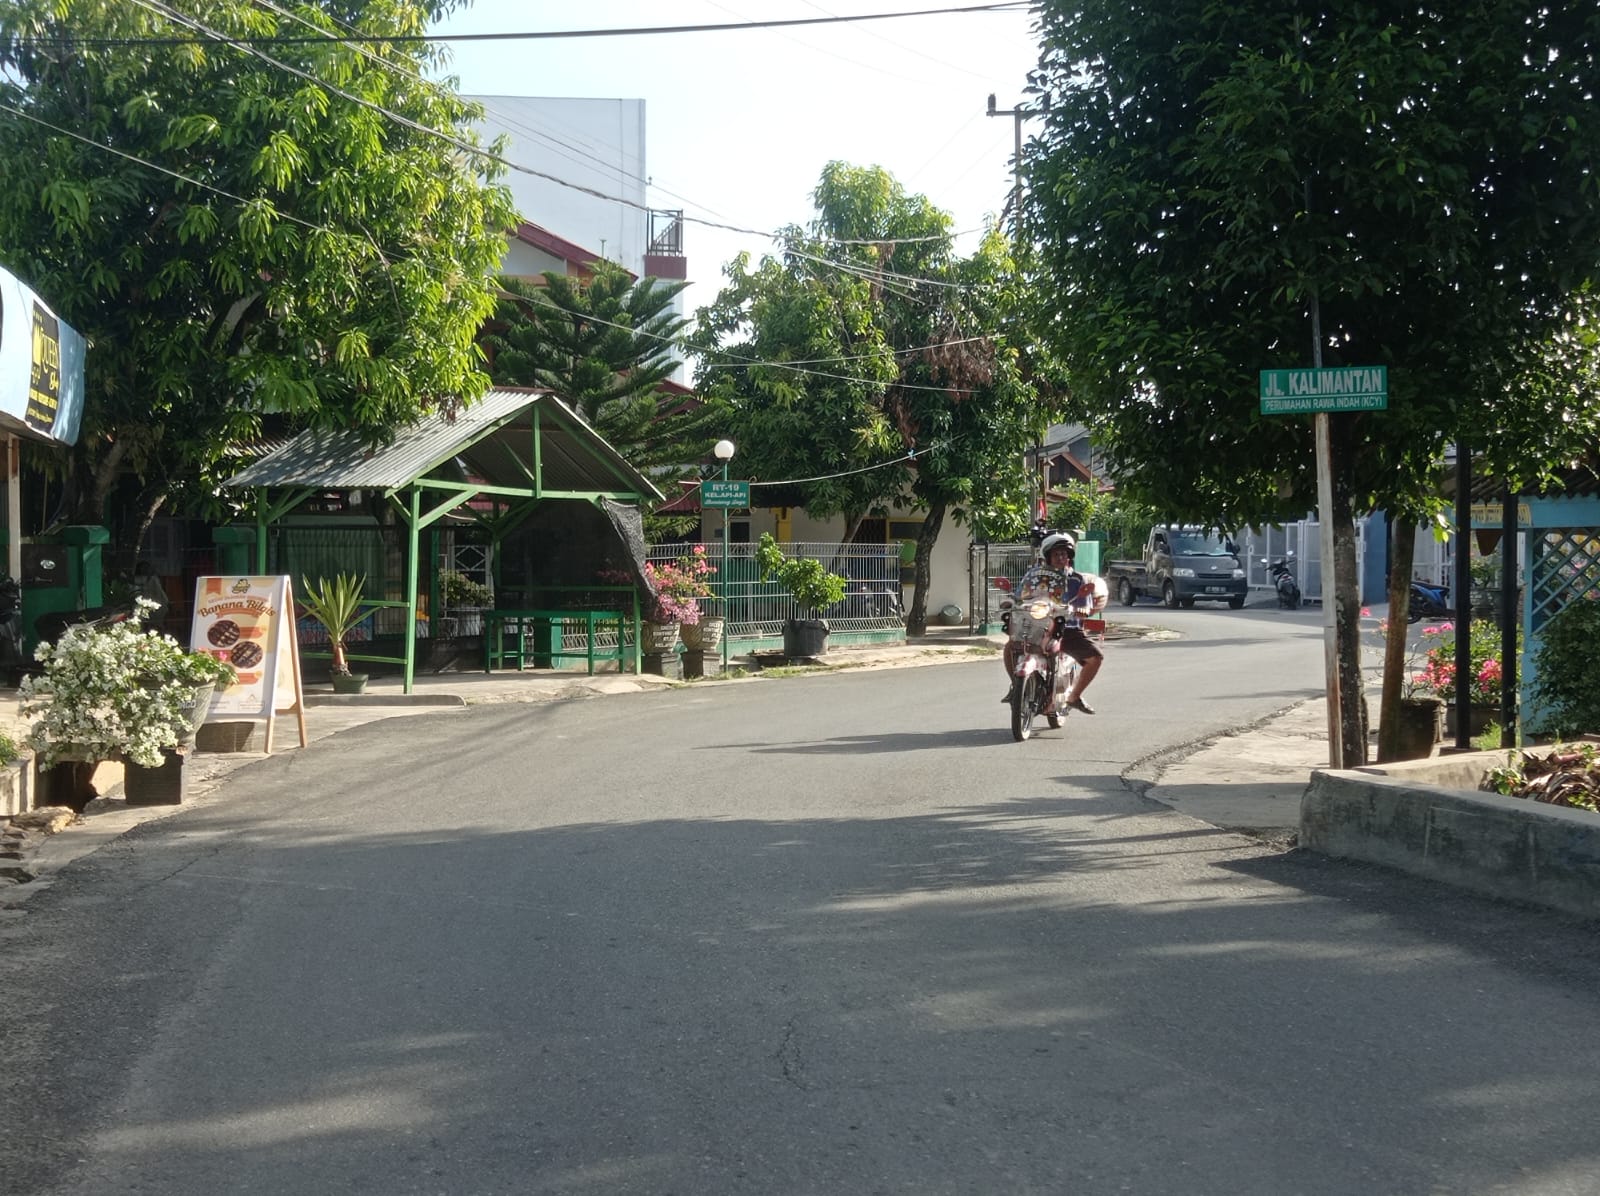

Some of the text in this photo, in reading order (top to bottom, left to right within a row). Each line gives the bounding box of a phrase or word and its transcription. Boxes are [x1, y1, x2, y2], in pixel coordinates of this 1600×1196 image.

[1265, 369, 1382, 396] JL. KALIMANTAN
[1265, 398, 1312, 411] PERUMAHAN
[1313, 398, 1335, 409] RAWA
[1336, 397, 1361, 408] INDAH
[199, 600, 244, 618] Banana
